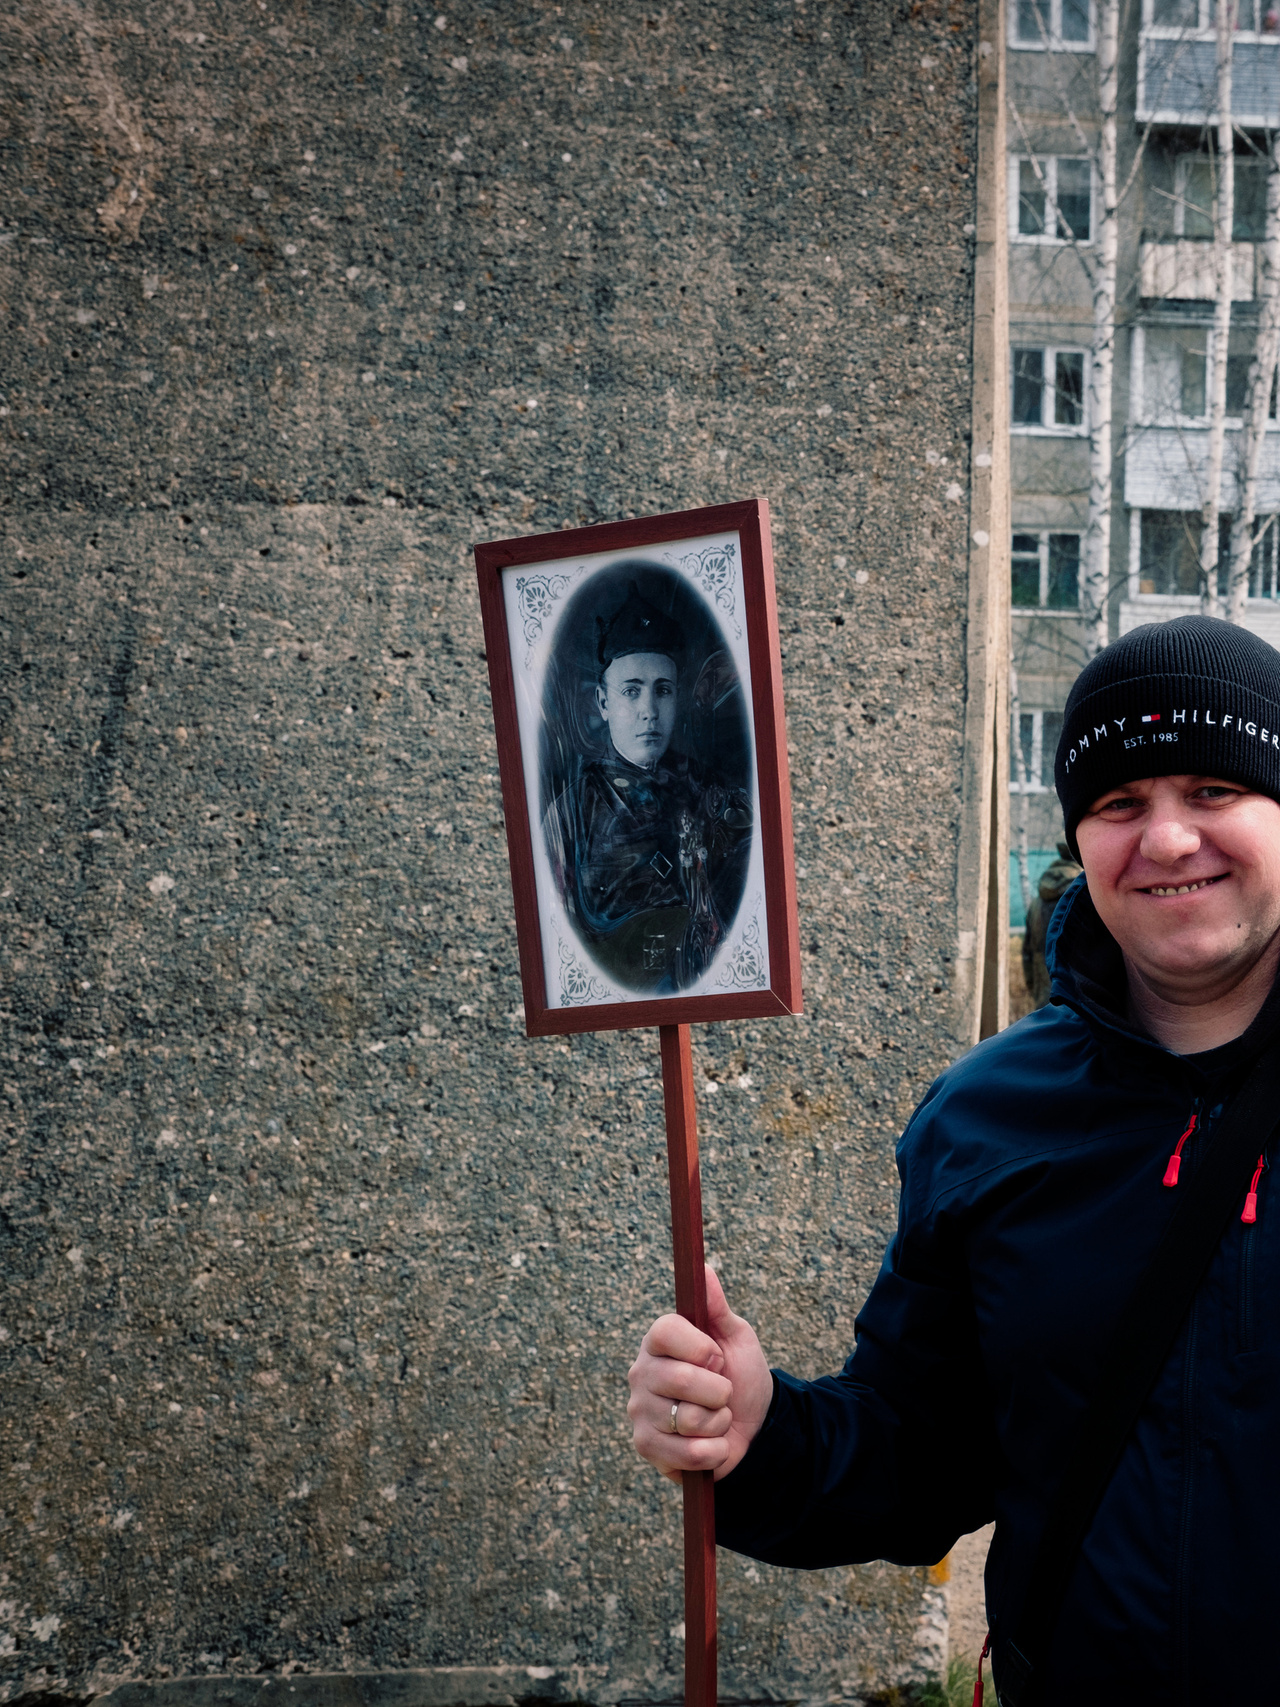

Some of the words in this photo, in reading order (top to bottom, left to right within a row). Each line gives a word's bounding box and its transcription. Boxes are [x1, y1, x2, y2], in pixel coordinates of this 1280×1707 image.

[1123, 735, 1147, 749] EST.
[1153, 732, 1179, 744] 1985
[1173, 709, 1280, 750] HILFIGER
